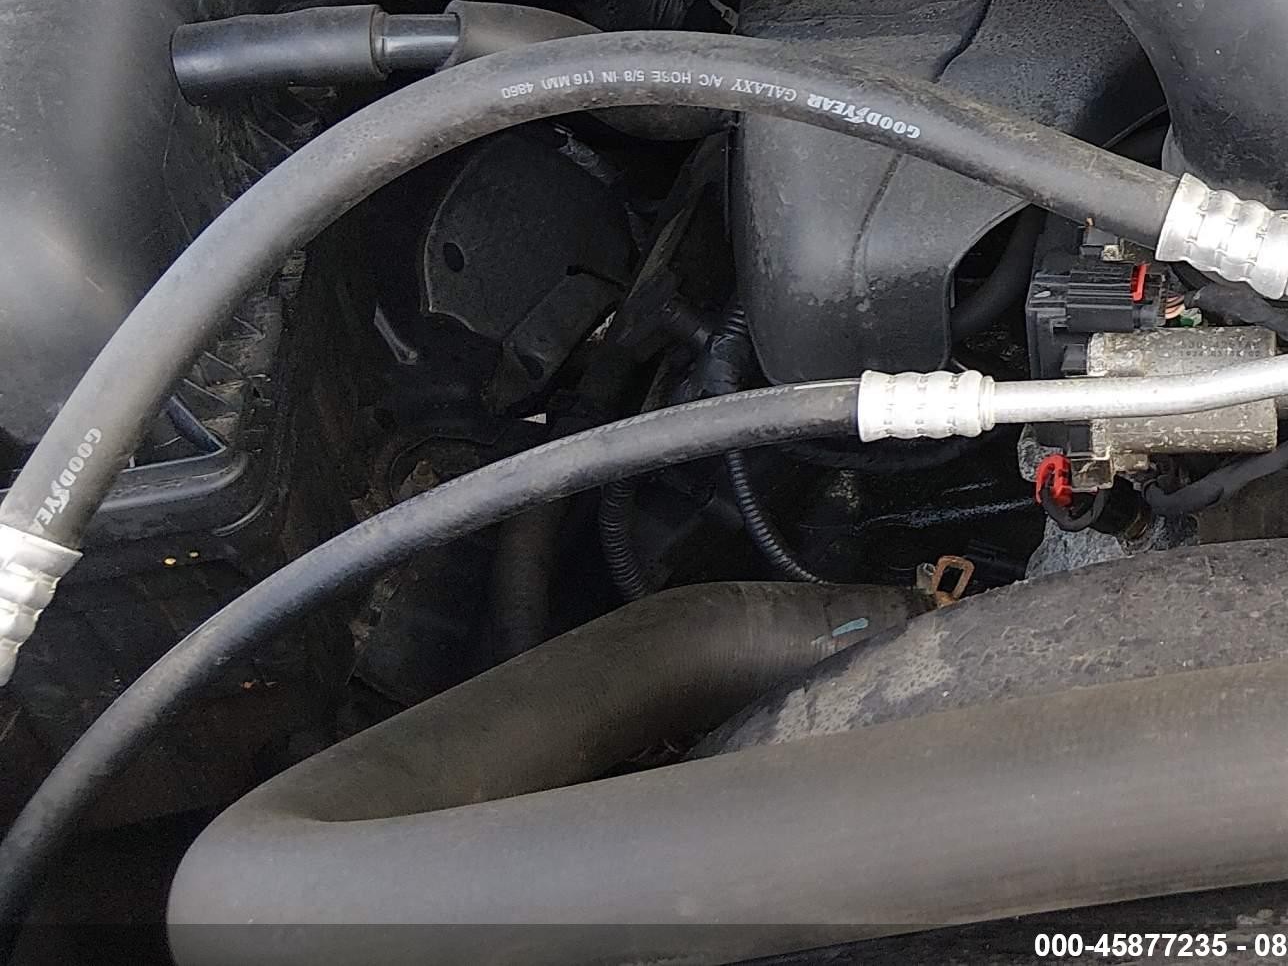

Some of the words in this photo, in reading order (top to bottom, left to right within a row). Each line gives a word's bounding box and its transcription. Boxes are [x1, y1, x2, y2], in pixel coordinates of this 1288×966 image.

[543, 75, 571, 90] MM)
[574, 70, 594, 85] (16
[623, 70, 645, 83] 5/8
[652, 70, 692, 85] HOSE
[699, 74, 723, 87] A/C
[501, 82, 535, 99] 4860
[730, 78, 797, 102] GALAXY
[807, 93, 921, 139] GOODYEAR
[28, 428, 102, 534] GOODYEA
